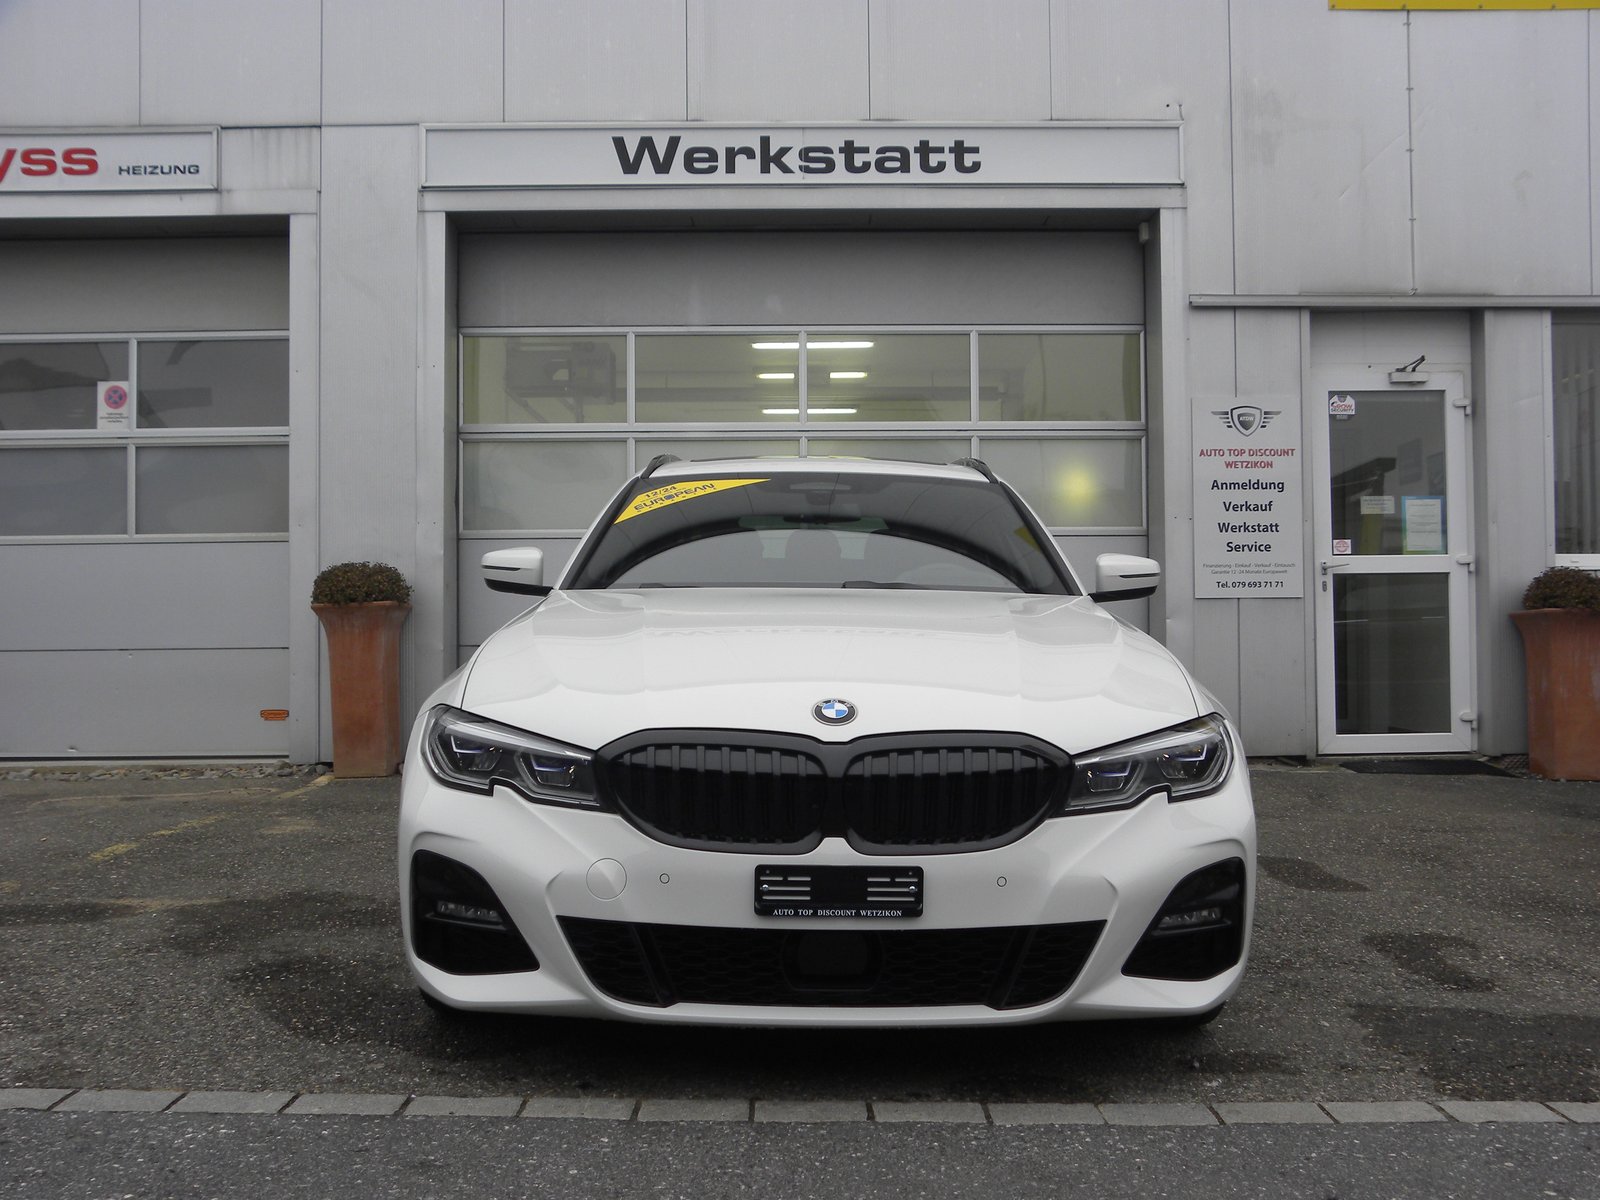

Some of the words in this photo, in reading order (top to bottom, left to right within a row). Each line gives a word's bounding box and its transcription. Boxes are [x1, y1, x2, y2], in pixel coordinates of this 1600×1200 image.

[611, 135, 981, 174] Werkstatt
[118, 165, 200, 175] HEIZUNG
[1199, 449, 1225, 457] AUTO
[1227, 449, 1246, 457] TOP
[1248, 449, 1296, 457] DISCOUNT
[1224, 461, 1273, 469] WETZIKON
[1211, 479, 1285, 493] Anmeldung
[633, 483, 715, 511] EUROPEAN
[645, 486, 677, 499] 12/24
[1223, 501, 1273, 512] Verkauf
[1218, 522, 1280, 533] Werkstatt
[1226, 541, 1272, 552] Service
